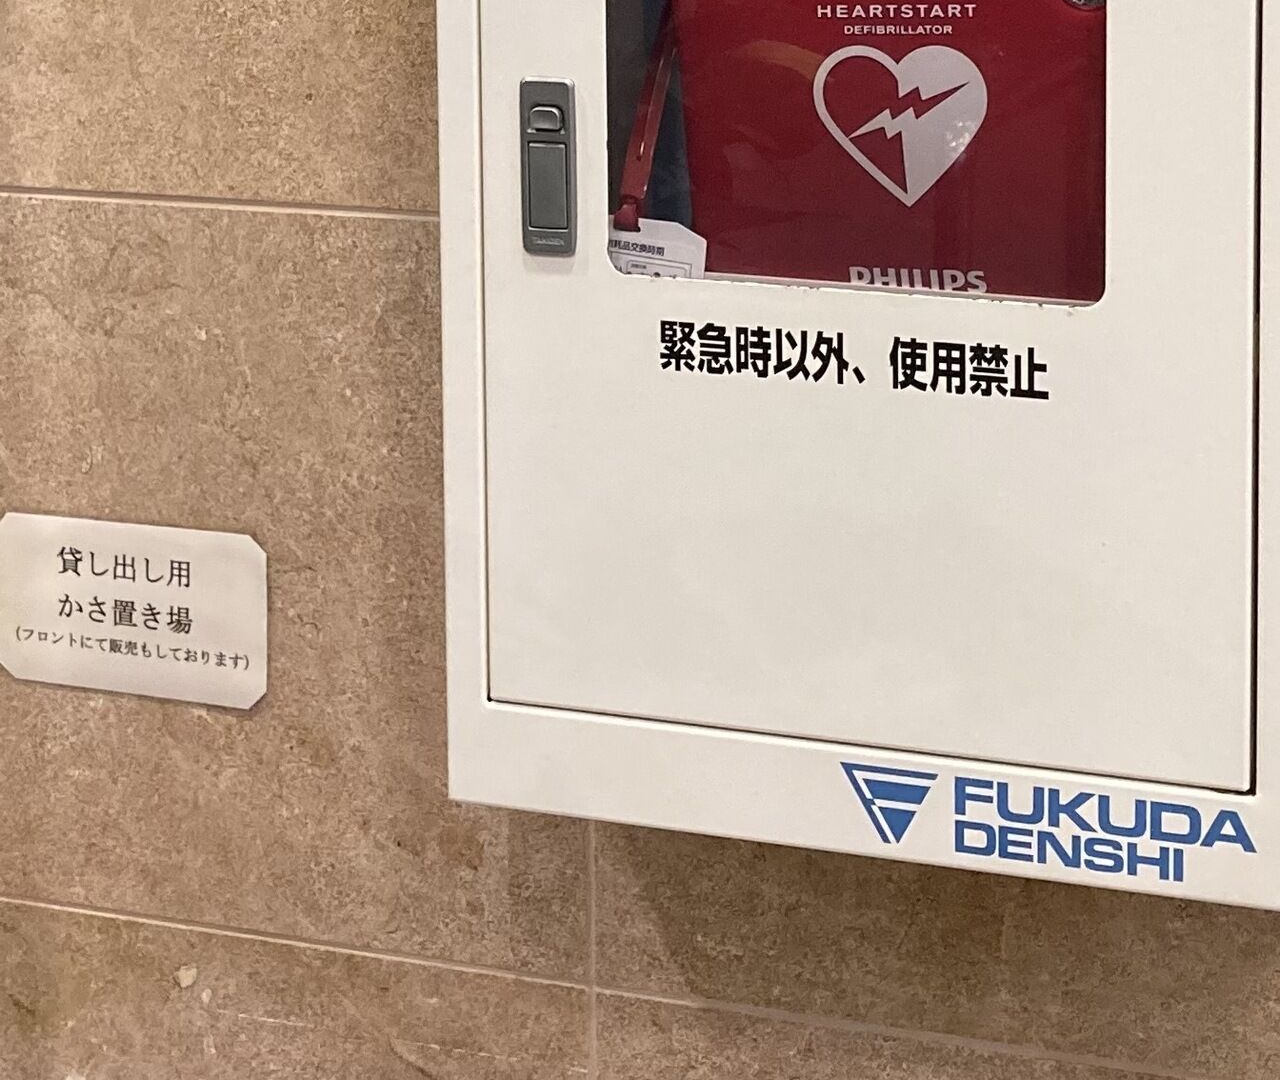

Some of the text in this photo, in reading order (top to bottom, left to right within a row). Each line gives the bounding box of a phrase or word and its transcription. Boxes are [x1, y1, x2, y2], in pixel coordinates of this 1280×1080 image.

[817, 4, 977, 18] HEARTSTART
[844, 25, 953, 36] DEFIBRILLATOR
[849, 266, 988, 293] PHILIPS
[659, 321, 1049, 400] 緊急時以外、使用禁止
[57, 546, 192, 588] 貸し出し用
[58, 593, 193, 635] かさ置き場
[954, 776, 1257, 853] FUKUDA
[954, 820, 1184, 882] DENSHI
